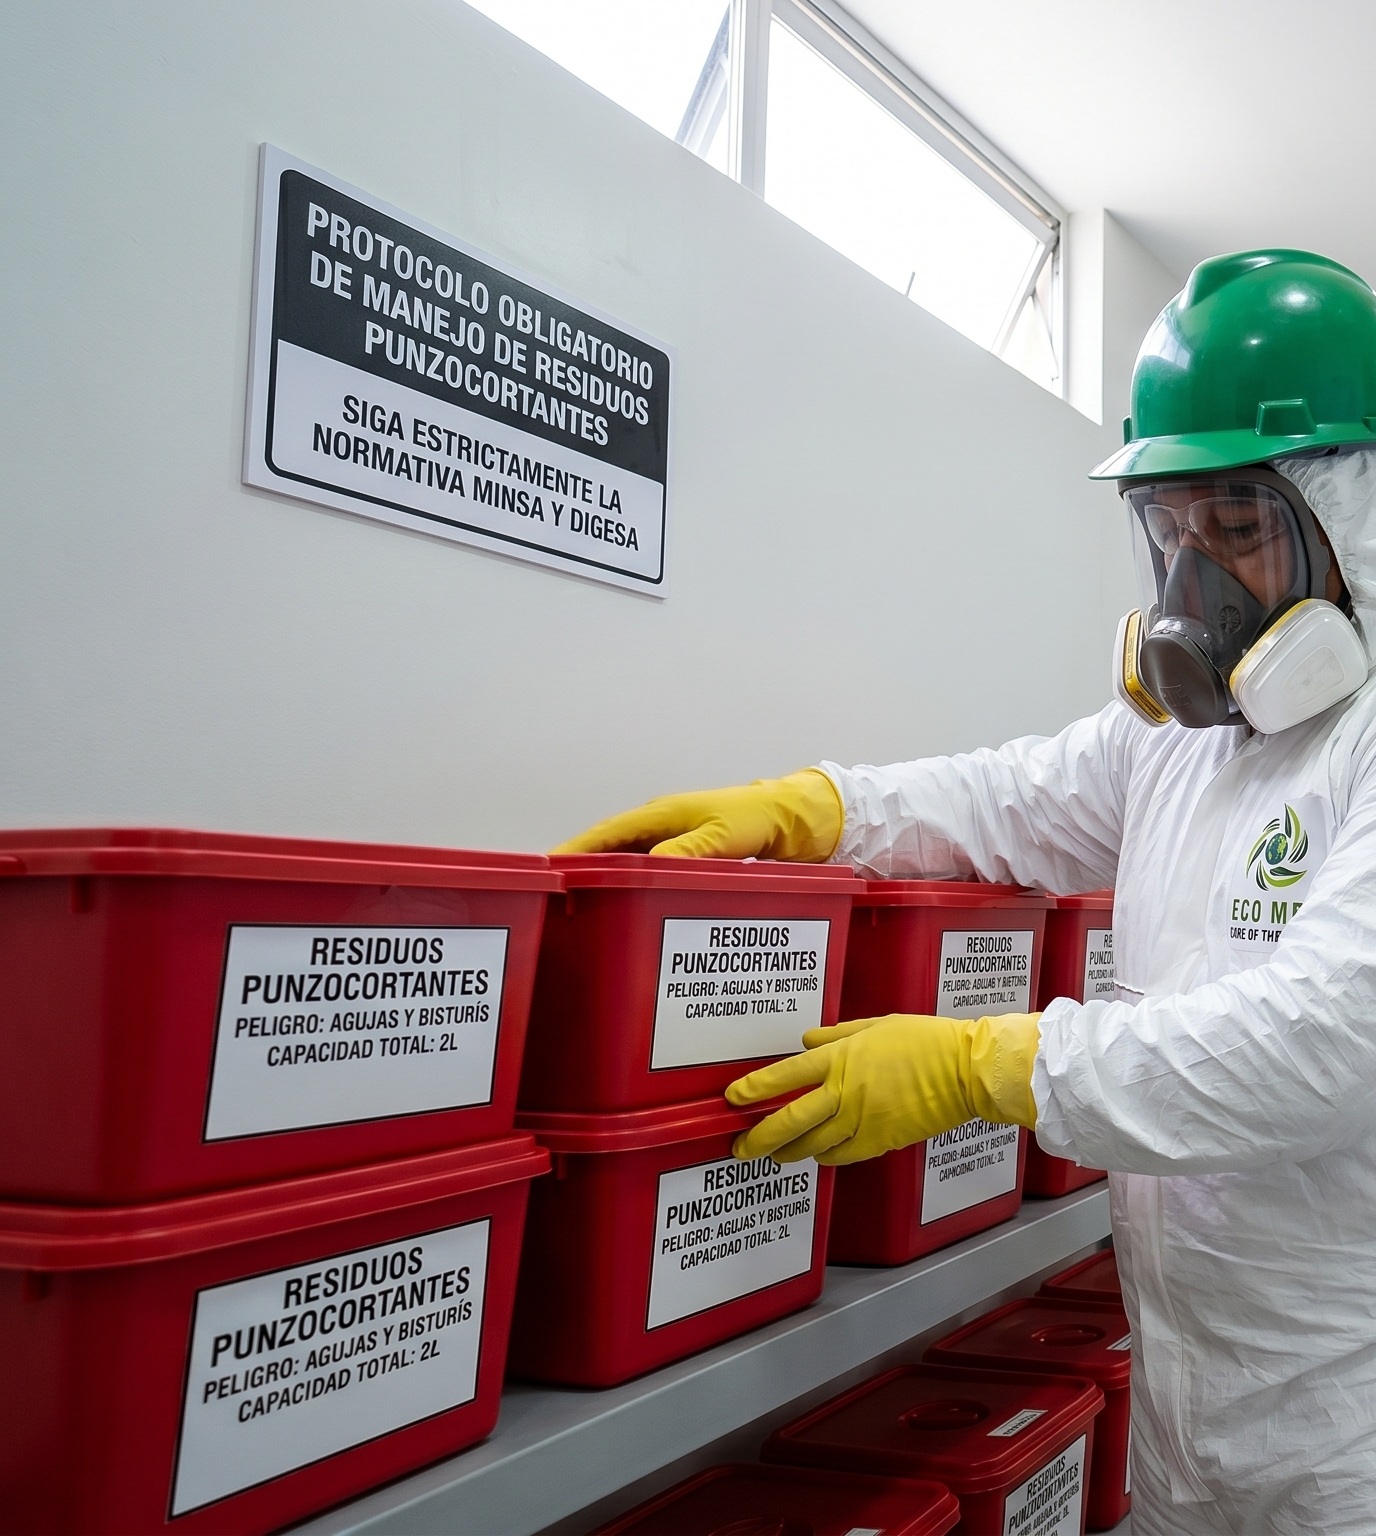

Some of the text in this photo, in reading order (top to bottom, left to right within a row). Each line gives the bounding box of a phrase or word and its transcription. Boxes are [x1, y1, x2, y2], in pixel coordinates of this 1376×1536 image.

[307, 202, 653, 389] PROTOCOLO OBLIGATORIO
[310, 251, 649, 425] DE MANEJO DE RESIDUOS
[365, 320, 608, 446] PUNZOCORTANTES
[343, 394, 622, 514] SIGA ESTRICTAMENTE LA
[313, 423, 638, 551] NORMATIVA MINSA Y DIGESA
[1232, 899, 1261, 923] ECO
[310, 938, 444, 966] RESIDUOS
[709, 927, 790, 947] RESIDUOS
[967, 937, 1012, 953] RESIDUOS
[1230, 927, 1246, 939] CARE
[1248, 929, 1258, 940] OF
[672, 951, 817, 974] PUNZOCORTANTES
[945, 955, 1027, 974] PUNZOCORTANTES
[241, 969, 489, 1004] PUNZOCORTANTES
[667, 974, 818, 998] PELIGRO: AGUJAS Y BISTURÍS
[235, 1001, 490, 1038] PELIGRO: AGUJAS Y BISTURÍS
[686, 999, 797, 1019] CAPACIDAD TOTAL: 2L
[267, 1033, 458, 1067] CAPACIDAD TOTAL: 2L
[704, 1156, 781, 1192] RESIDUOS
[666, 1172, 809, 1229] PUNZOCORTANTES
[662, 1196, 810, 1254] PELIGRO: AGUJAS Y BISTURÍS
[680, 1224, 790, 1271] CAPACIDAD TOTAL: 2L
[283, 1246, 423, 1309] RESIDUOS
[211, 1266, 470, 1368] PUNZOCORTANTES
[203, 1299, 472, 1404] PELIGRO: AGUJAS Y BISTURÍS
[238, 1339, 440, 1423] CAPACIDAD TOTAL: 2L
